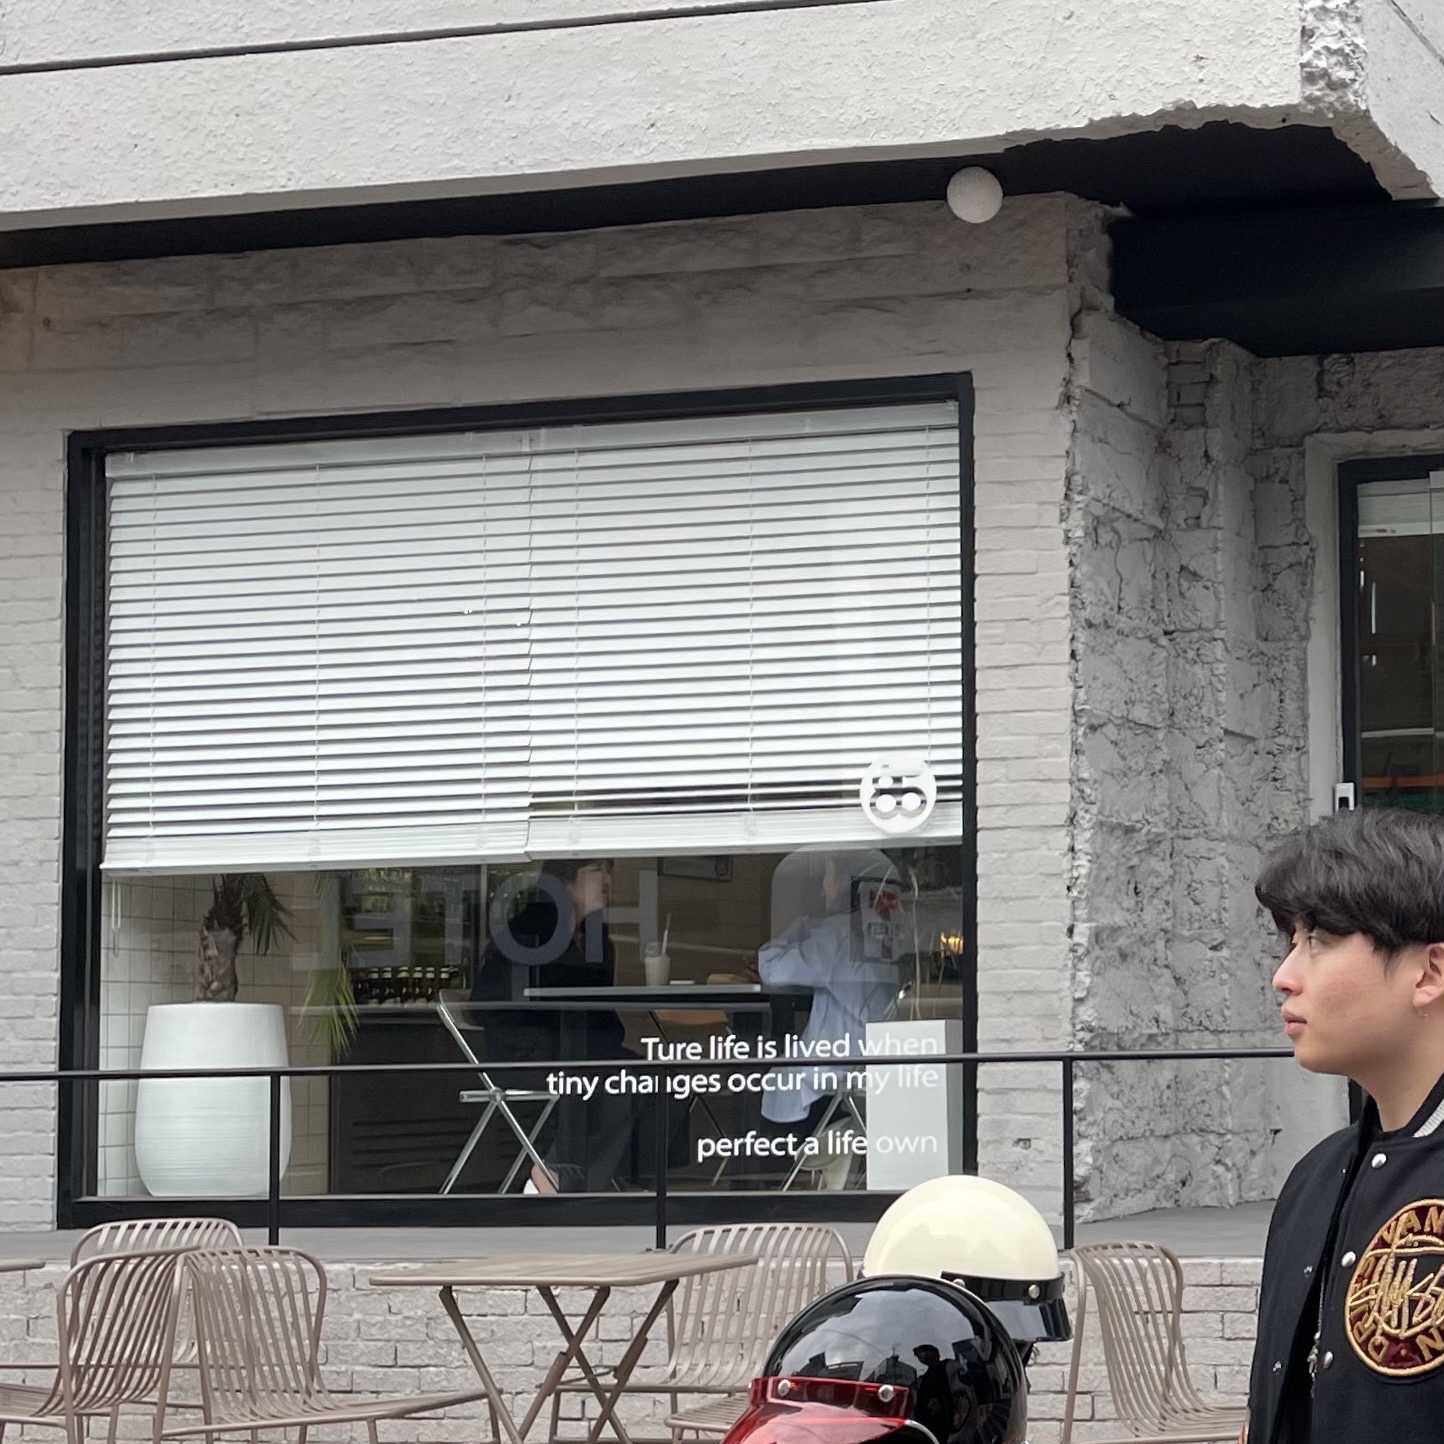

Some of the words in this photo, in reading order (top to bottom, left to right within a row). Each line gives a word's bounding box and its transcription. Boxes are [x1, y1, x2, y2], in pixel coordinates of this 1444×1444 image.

[640, 1037, 703, 1061] Ture
[709, 1035, 749, 1060] life
[757, 1035, 778, 1059] is
[784, 1032, 850, 1058] lived
[858, 1032, 938, 1056] when
[545, 1071, 599, 1101] tiny
[727, 1073, 806, 1092] occur
[813, 1067, 838, 1091] in
[846, 1071, 890, 1095] my
[898, 1064, 939, 1088] life
[697, 1130, 798, 1162] perfect
[803, 1135, 820, 1155] a
[827, 1129, 868, 1155] life
[875, 1135, 938, 1154] own
